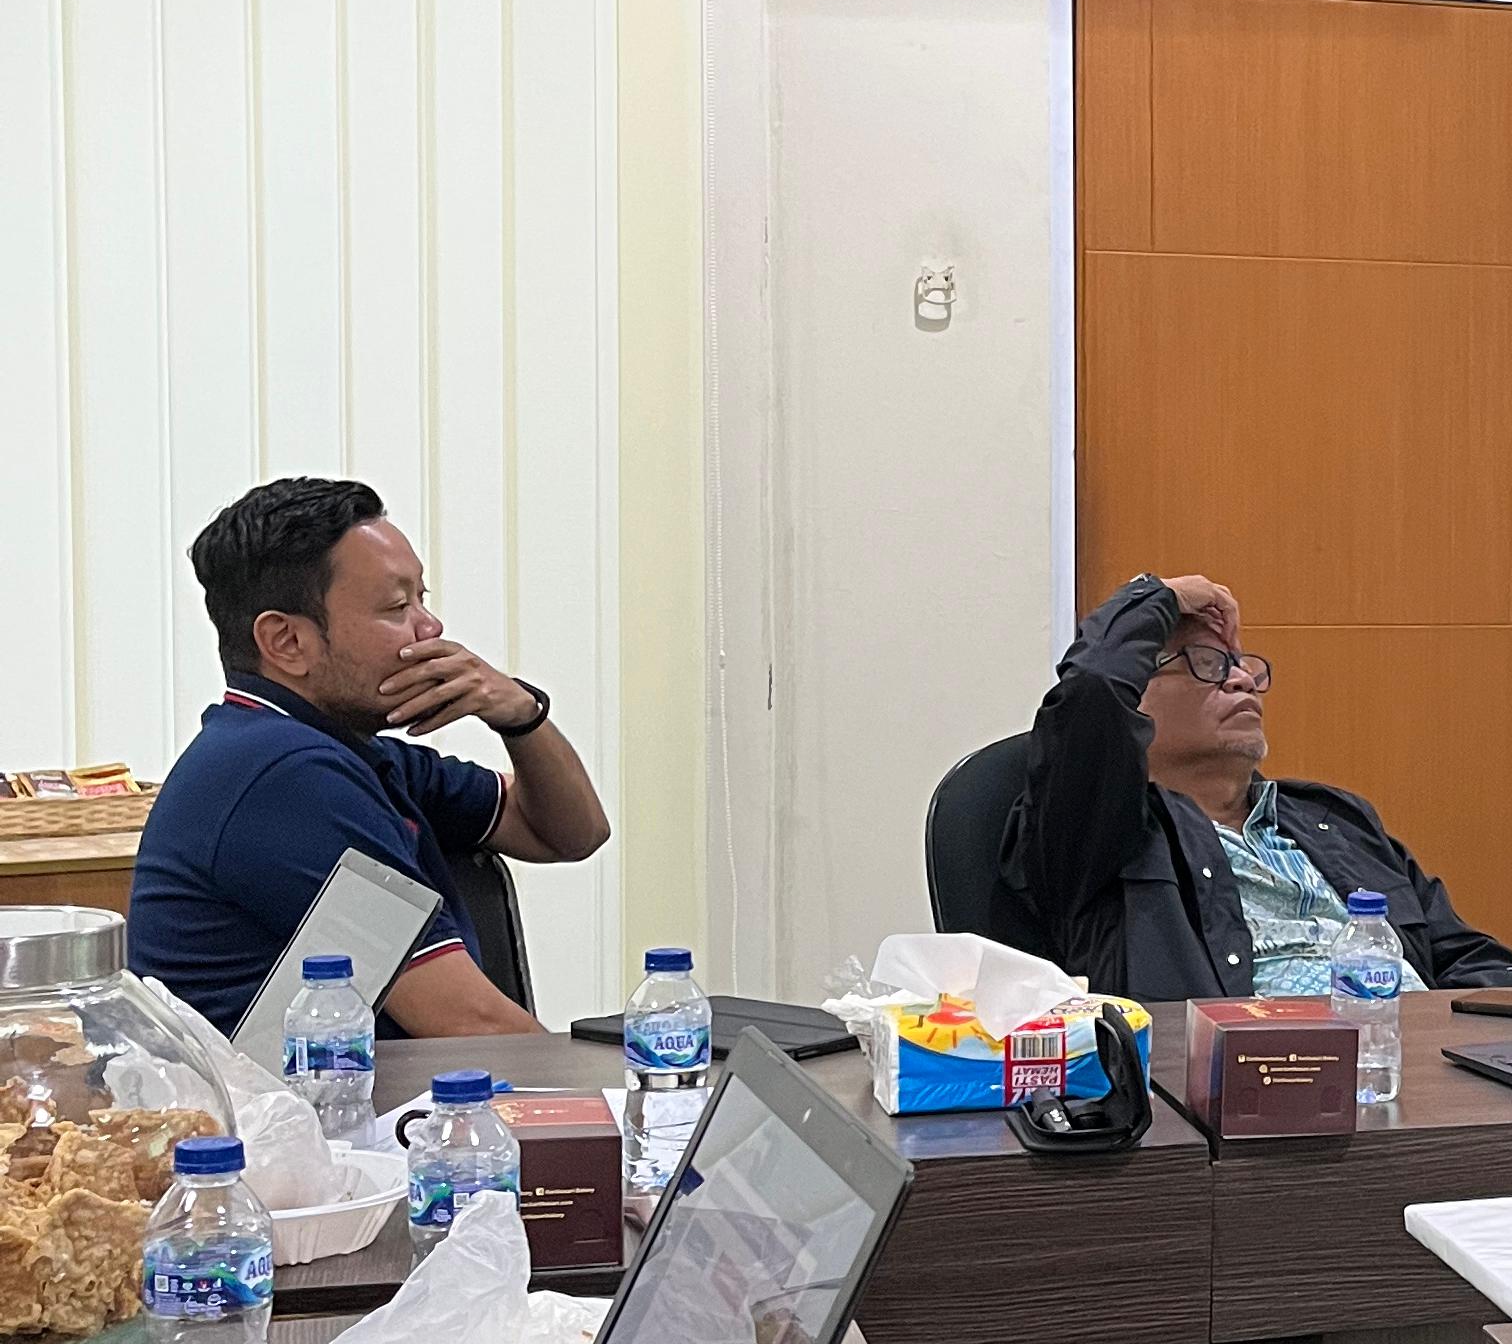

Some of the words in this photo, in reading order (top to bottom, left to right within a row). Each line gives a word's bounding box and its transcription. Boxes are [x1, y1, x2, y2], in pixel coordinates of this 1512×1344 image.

[1364, 971, 1395, 985] AQUA
[654, 1034, 694, 1052] AQUA
[1014, 1066, 1059, 1075] HEMAT
[1014, 1075, 1058, 1086] PASTI
